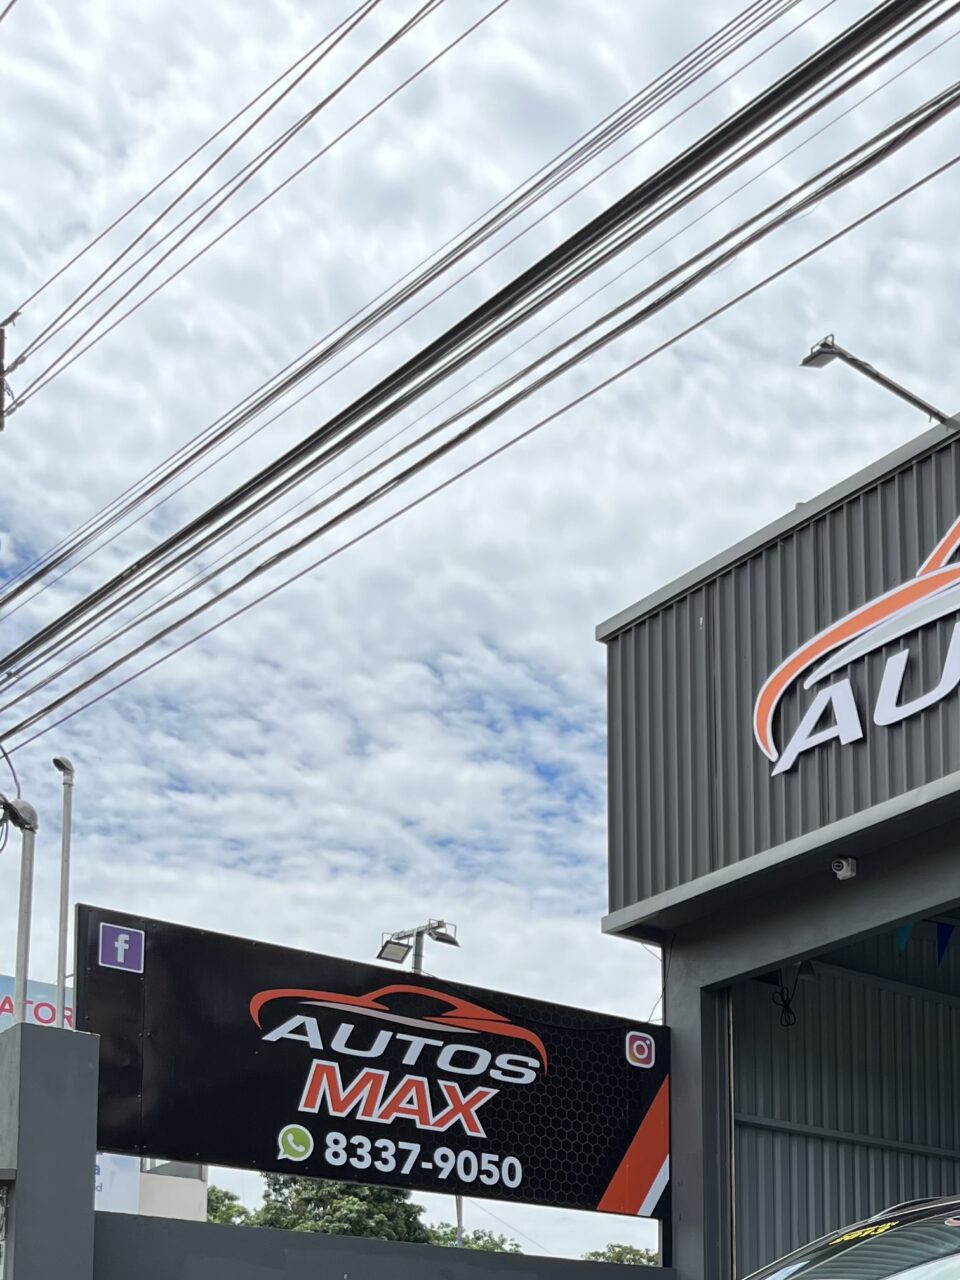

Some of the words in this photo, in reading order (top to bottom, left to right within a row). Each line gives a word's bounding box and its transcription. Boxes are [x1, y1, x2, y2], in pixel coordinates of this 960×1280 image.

[261, 1014, 541, 1085] AUTOS
[297, 1058, 500, 1139] MAX
[324, 1131, 523, 1189] 8337-9050
